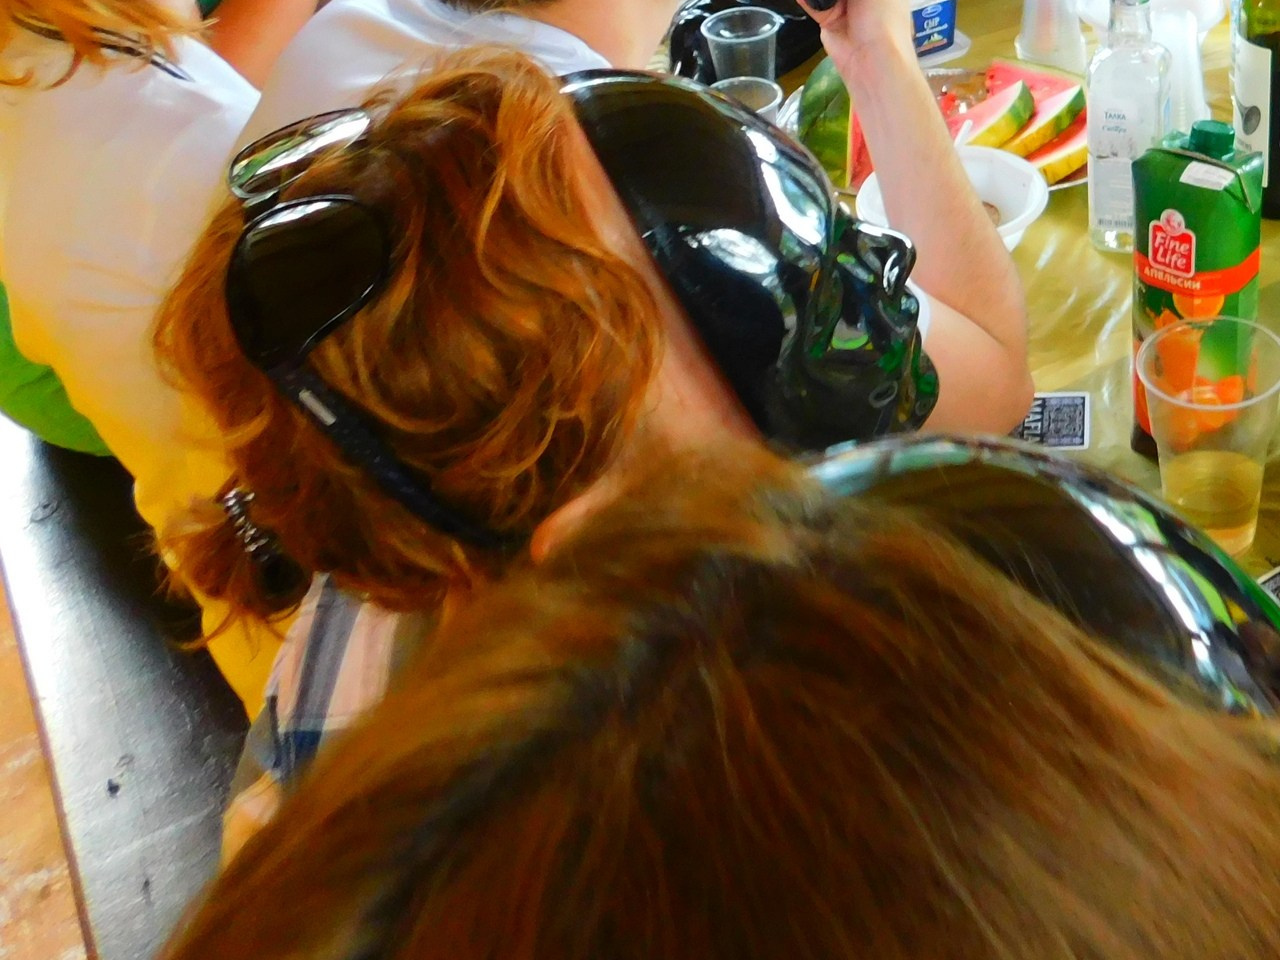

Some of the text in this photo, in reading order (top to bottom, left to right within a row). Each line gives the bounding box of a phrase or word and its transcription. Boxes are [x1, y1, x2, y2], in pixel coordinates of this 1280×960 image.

[1154, 230, 1190, 255] Fine
[1156, 245, 1187, 269] Life
[1144, 266, 1201, 290] АПЕЛЬСИН
